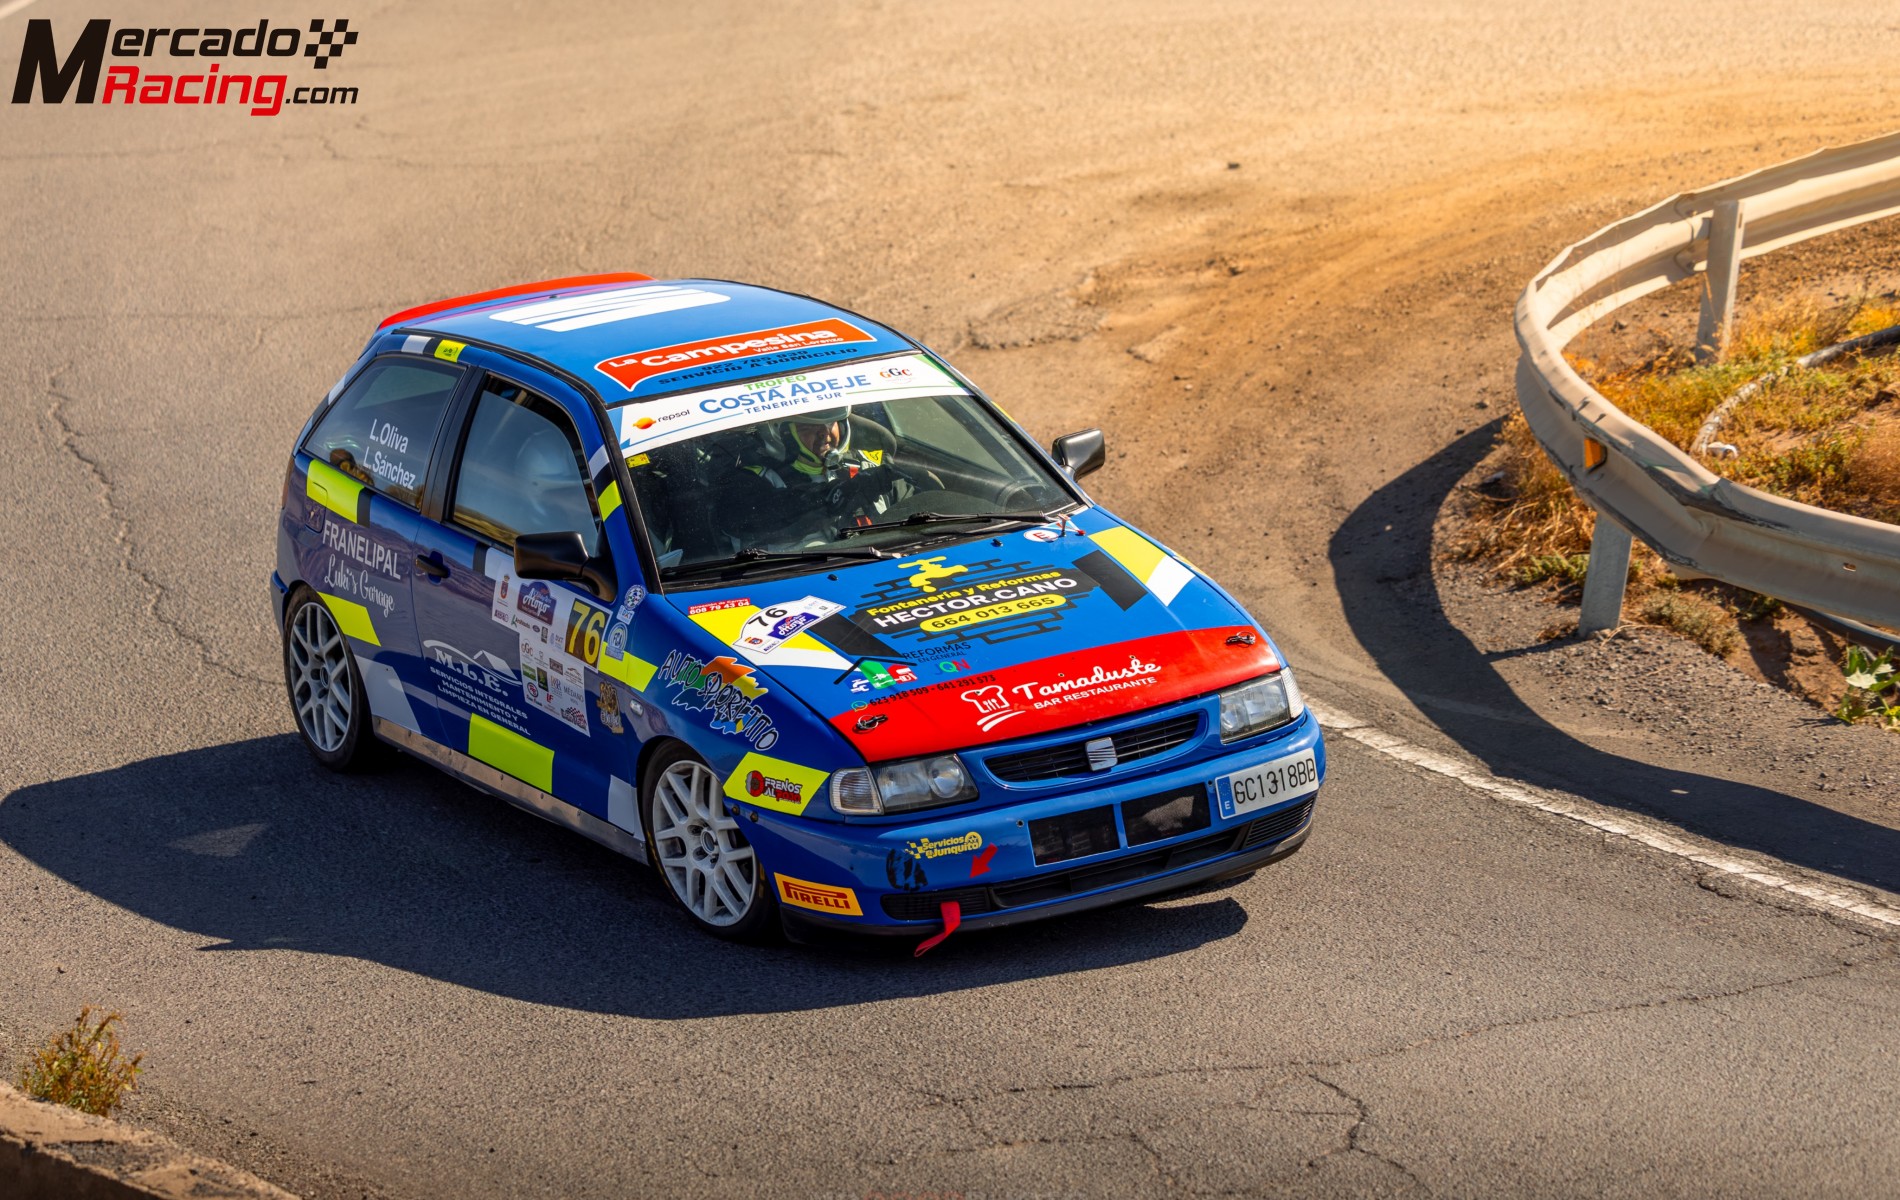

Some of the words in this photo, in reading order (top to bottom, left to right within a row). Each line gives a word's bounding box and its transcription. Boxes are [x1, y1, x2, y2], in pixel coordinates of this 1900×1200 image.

[608, 356, 639, 369] La
[641, 327, 839, 368] Campesina
[753, 345, 779, 354] Valle
[658, 364, 742, 385] SERVICIO
[765, 347, 858, 367] DOMICILIO
[744, 375, 807, 391] TROFEO
[791, 374, 872, 397] ADEJE
[658, 409, 690, 423] repsol
[744, 396, 810, 415] TENERIFE
[817, 391, 843, 402] SUR
[322, 519, 401, 580] FRANELIPAL
[360, 569, 396, 618] Garage
[962, 587, 975, 596] y
[976, 571, 1061, 591] Reformas
[748, 607, 788, 627] 76
[873, 578, 1077, 628] HECTOR.CANO
[932, 614, 970, 629] 664
[977, 605, 1012, 619] 013
[1016, 597, 1055, 610] 665
[568, 600, 605, 665] 76
[902, 641, 972, 659] REFORMAS
[930, 650, 967, 661] GENERAL
[658, 649, 703, 688] AUTO
[1011, 658, 1162, 699] Tamaduste
[430, 666, 474, 692] SERVICIOS
[475, 688, 528, 719] INTEGRALES
[441, 680, 511, 718] MANTENIMIENTO
[889, 691, 910, 701] 918
[911, 686, 930, 696] 509
[937, 682, 955, 692] 641
[958, 678, 977, 687] 291
[978, 674, 996, 684] 573
[1033, 697, 1060, 709] BAR
[1063, 676, 1157, 702] RESTAURANTE
[437, 684, 478, 709] LIMPIEZA
[477, 705, 489, 716] EN
[490, 711, 531, 737] GENERAL
[764, 777, 803, 795] FRENOS
[764, 787, 776, 798] AL
[1224, 800, 1231, 810] E
[922, 836, 964, 851] Servicios
[782, 880, 851, 910] PIRELLI
